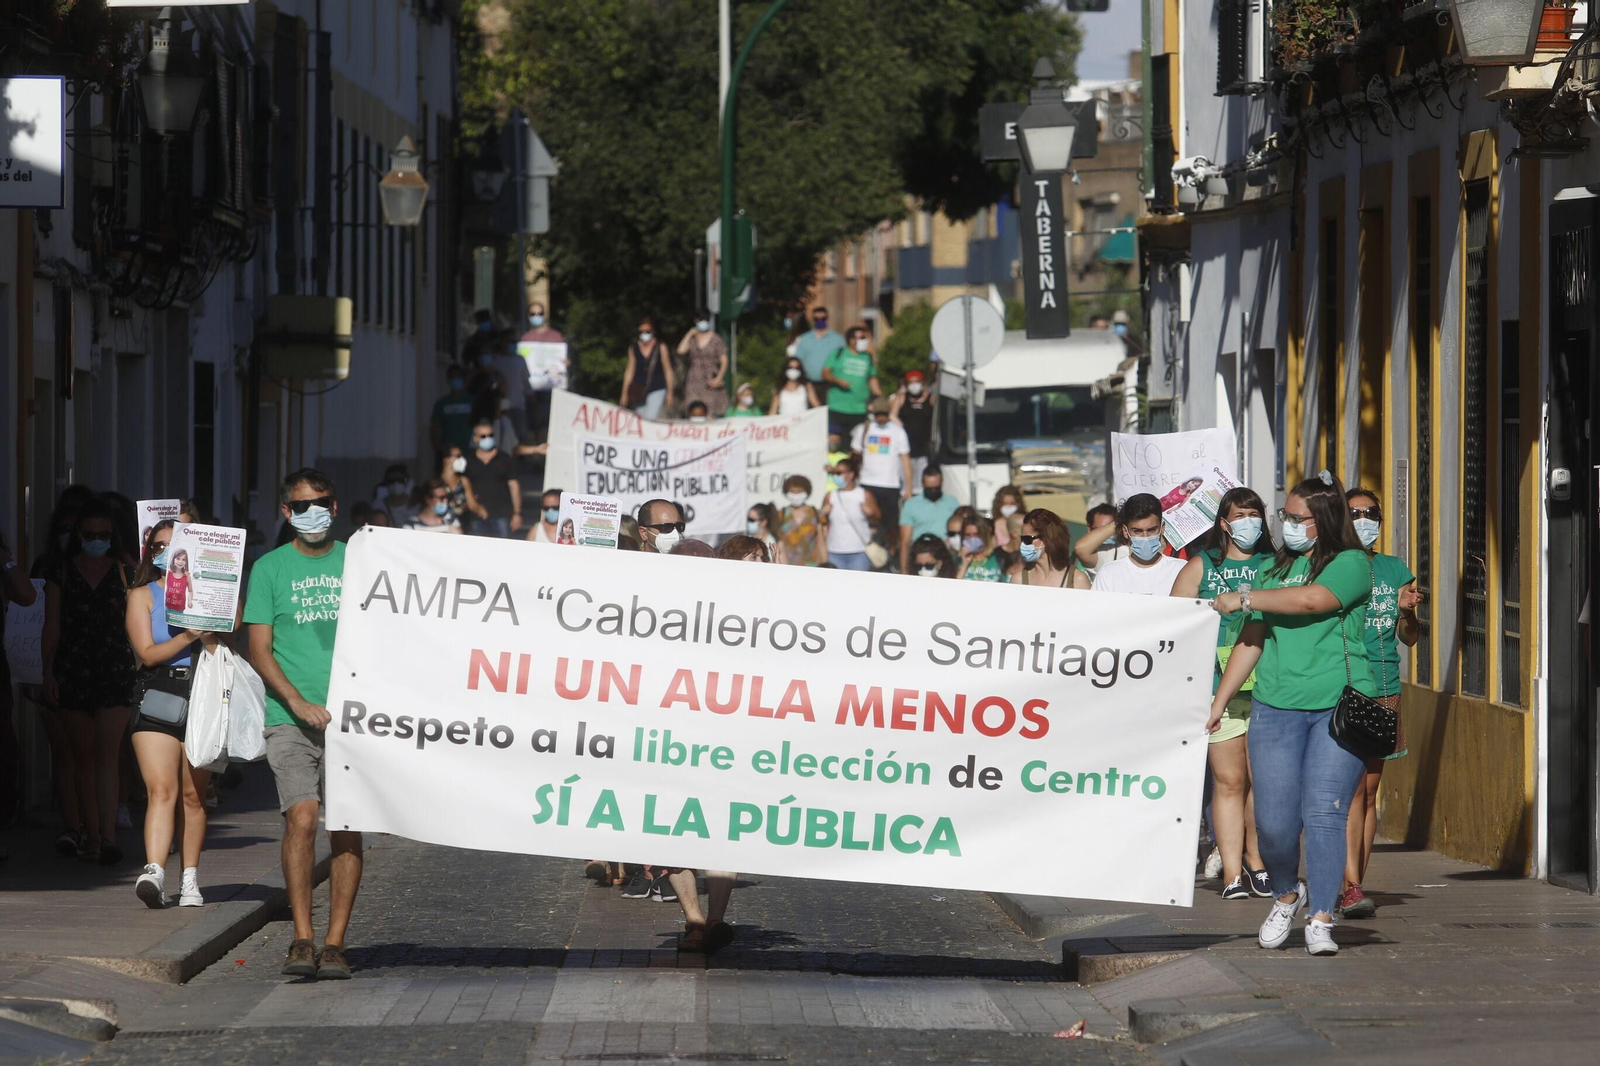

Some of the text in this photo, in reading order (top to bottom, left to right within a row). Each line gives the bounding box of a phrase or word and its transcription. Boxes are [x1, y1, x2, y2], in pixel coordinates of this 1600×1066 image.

[13, 170, 32, 181] del
[1034, 180, 1057, 308] TABERNA
[572, 402, 643, 438] AMPA
[585, 443, 618, 469] POR
[632, 449, 668, 470] UNA
[1118, 442, 1162, 469] NO
[1121, 472, 1181, 487] CIERRE
[570, 498, 591, 506] Quiero
[591, 500, 609, 508] elegir
[183, 528, 208, 536] Quiero
[209, 531, 230, 539] elegir
[215, 538, 241, 546] público
[301, 597, 316, 607] DE
[360, 571, 520, 626] AMPA
[846, 616, 907, 661] de
[467, 649, 1050, 740] NI UN AULA MENOS
[342, 700, 1167, 800] Respeto a la libre elección de Centro
[532, 773, 962, 857] SÍ A LA PÚBLICA
